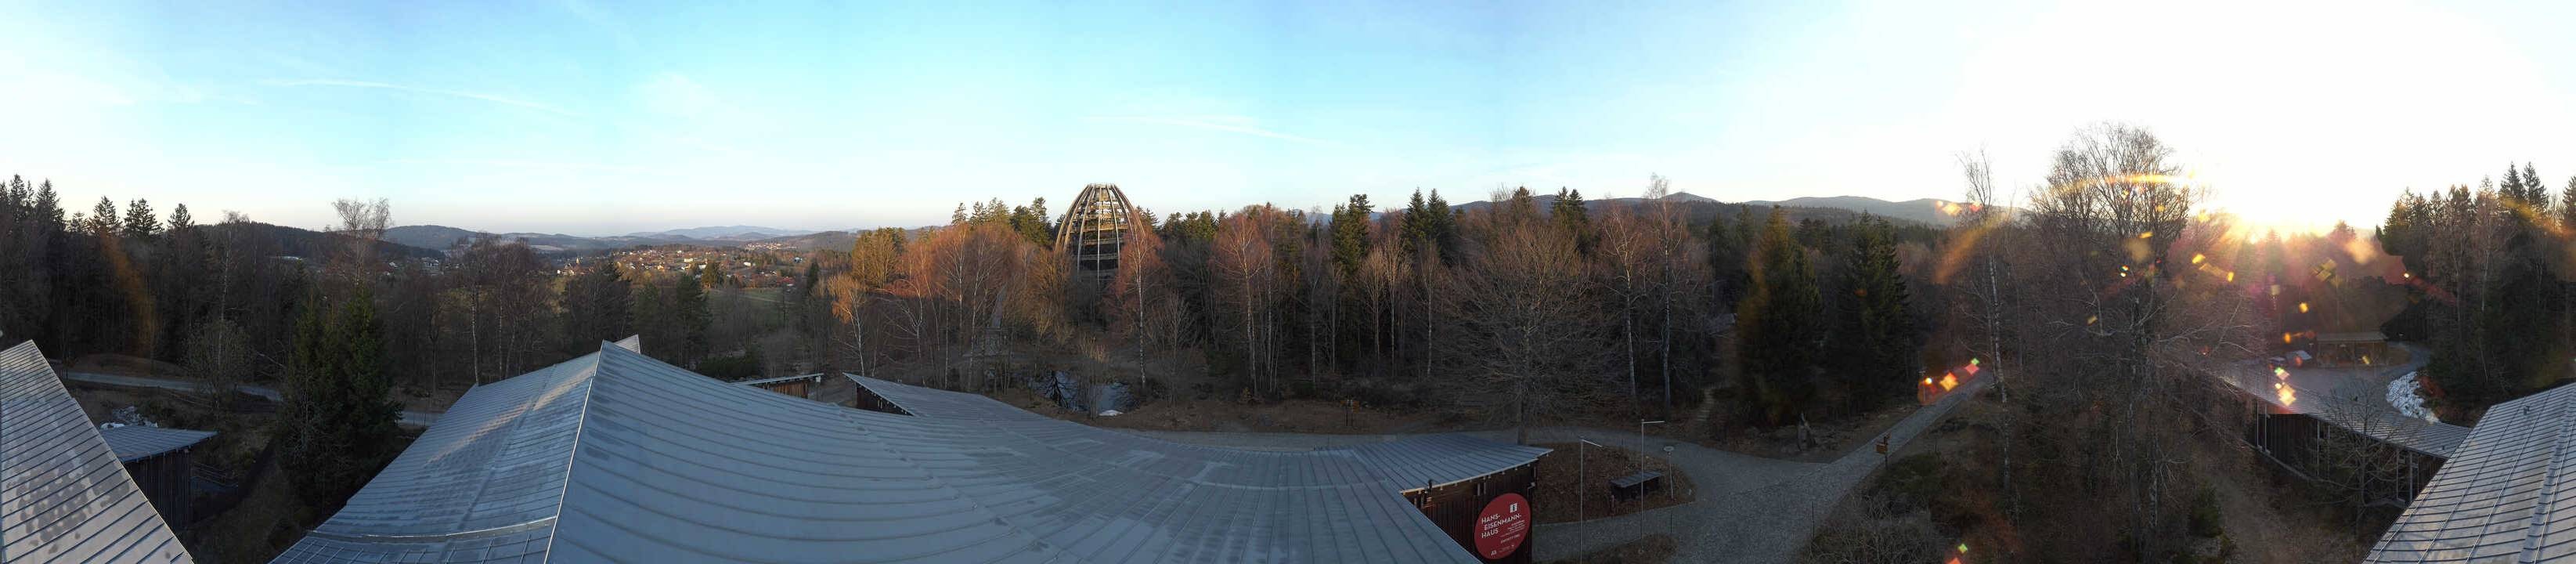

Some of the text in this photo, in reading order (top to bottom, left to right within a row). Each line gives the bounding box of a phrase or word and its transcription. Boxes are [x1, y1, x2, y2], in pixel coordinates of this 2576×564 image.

[1481, 513, 1500, 524] HANS-
[1484, 513, 1522, 530] EISENMANN-
[1481, 529, 1499, 538] HAUS
